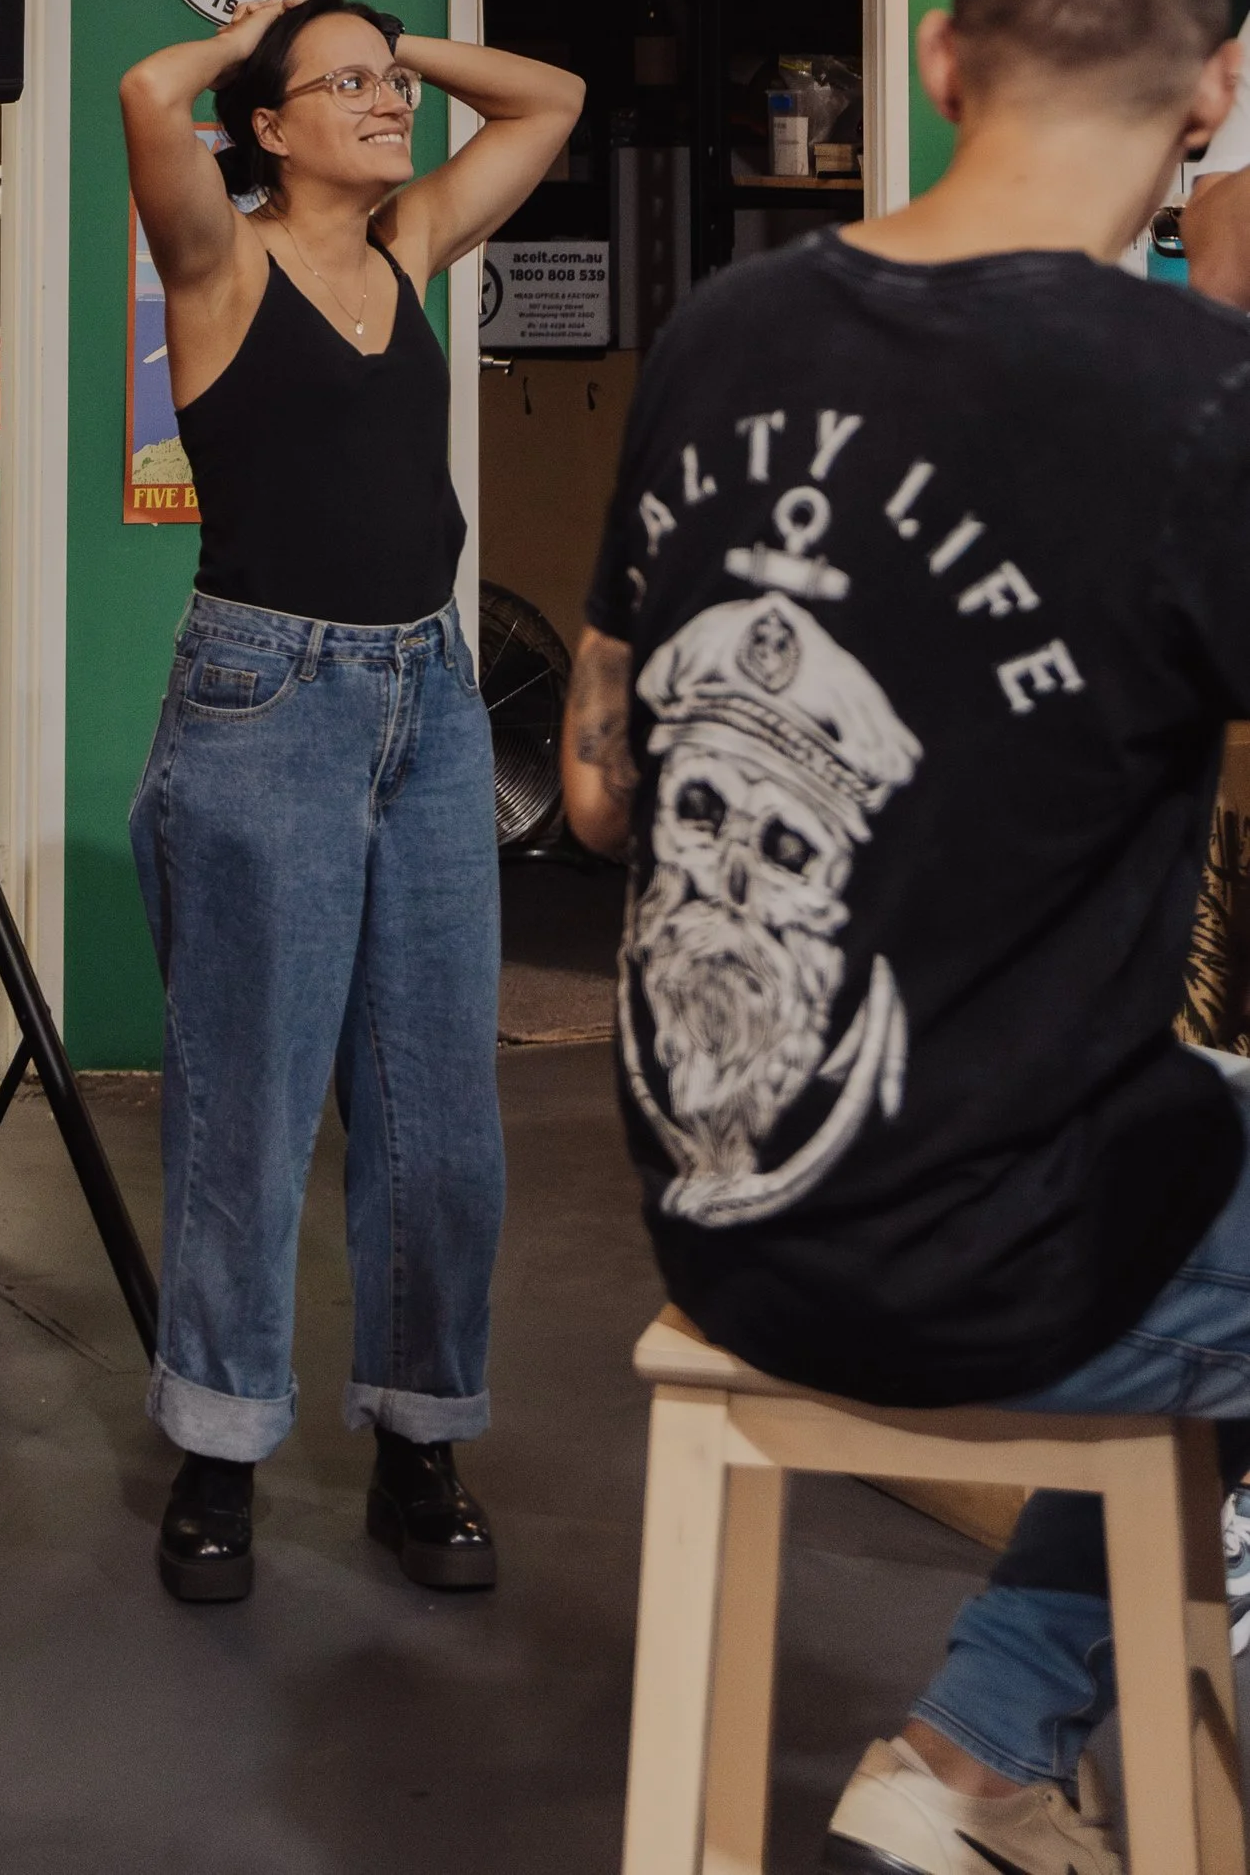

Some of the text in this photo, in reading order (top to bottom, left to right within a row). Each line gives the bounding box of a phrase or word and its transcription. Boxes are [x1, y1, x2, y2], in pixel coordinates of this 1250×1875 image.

[510, 269, 606, 282] 1800 808 539
[133, 487, 179, 509] FIVE
[885, 457, 1086, 715] LIFE
